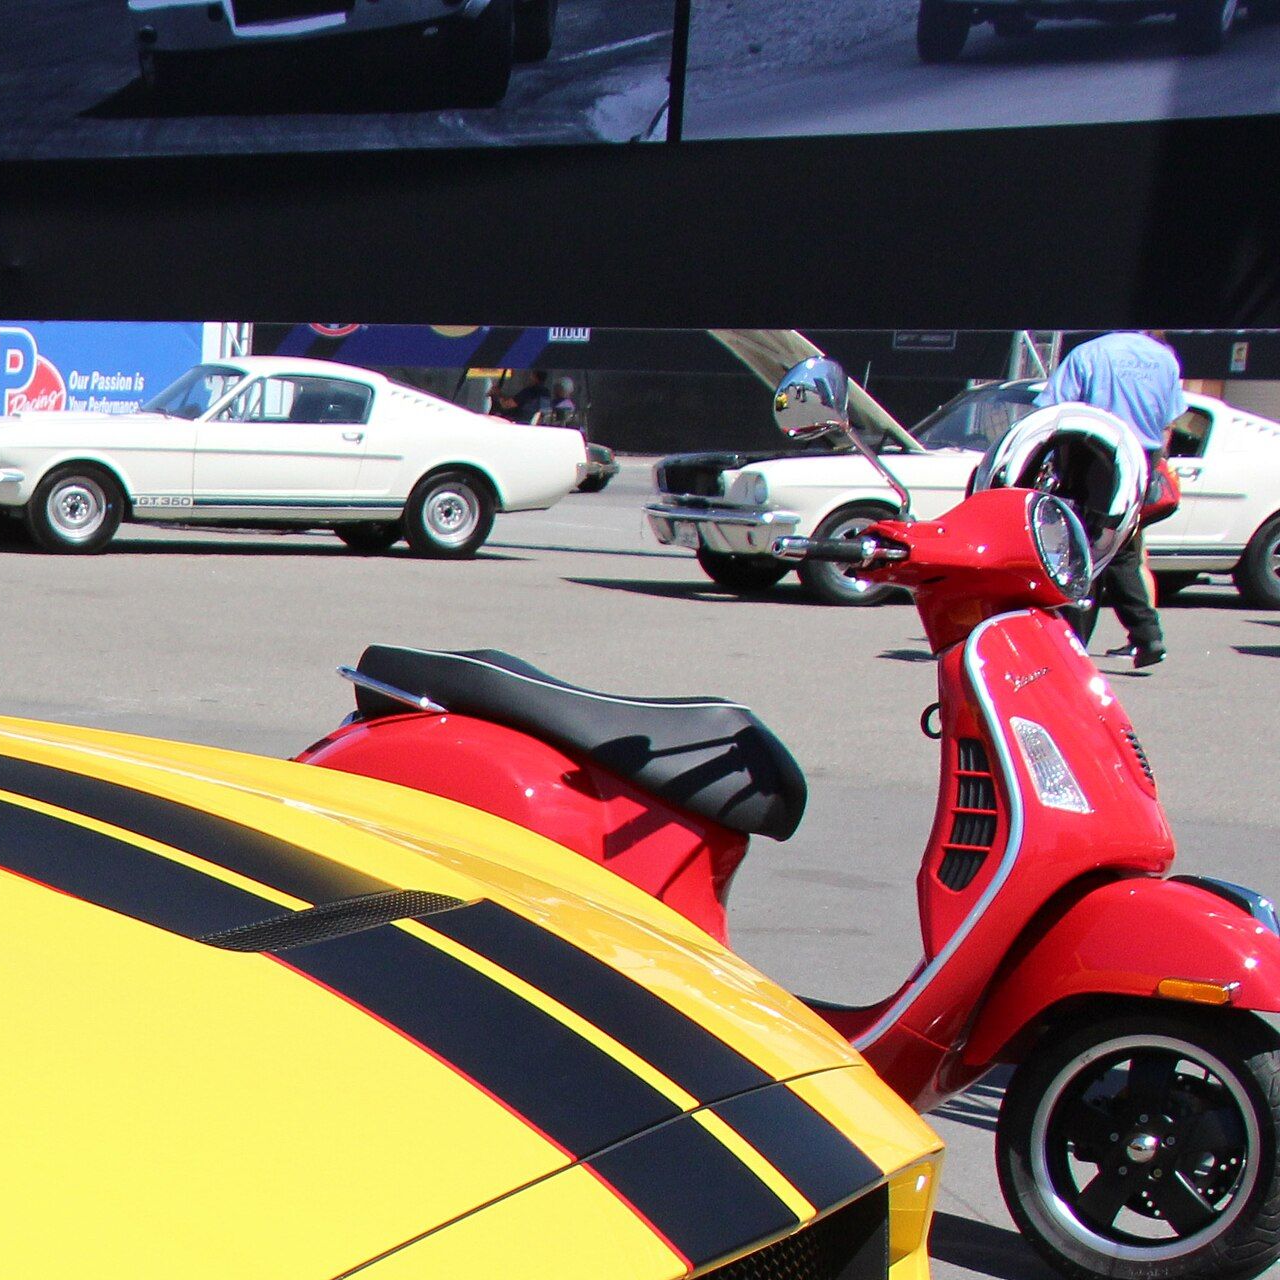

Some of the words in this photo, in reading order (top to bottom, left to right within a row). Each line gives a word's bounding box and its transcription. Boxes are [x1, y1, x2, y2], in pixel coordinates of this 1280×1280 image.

[69, 370, 88, 390] Our
[91, 371, 132, 391] Passion
[134, 372, 145, 391] is
[69, 395, 88, 412] Your
